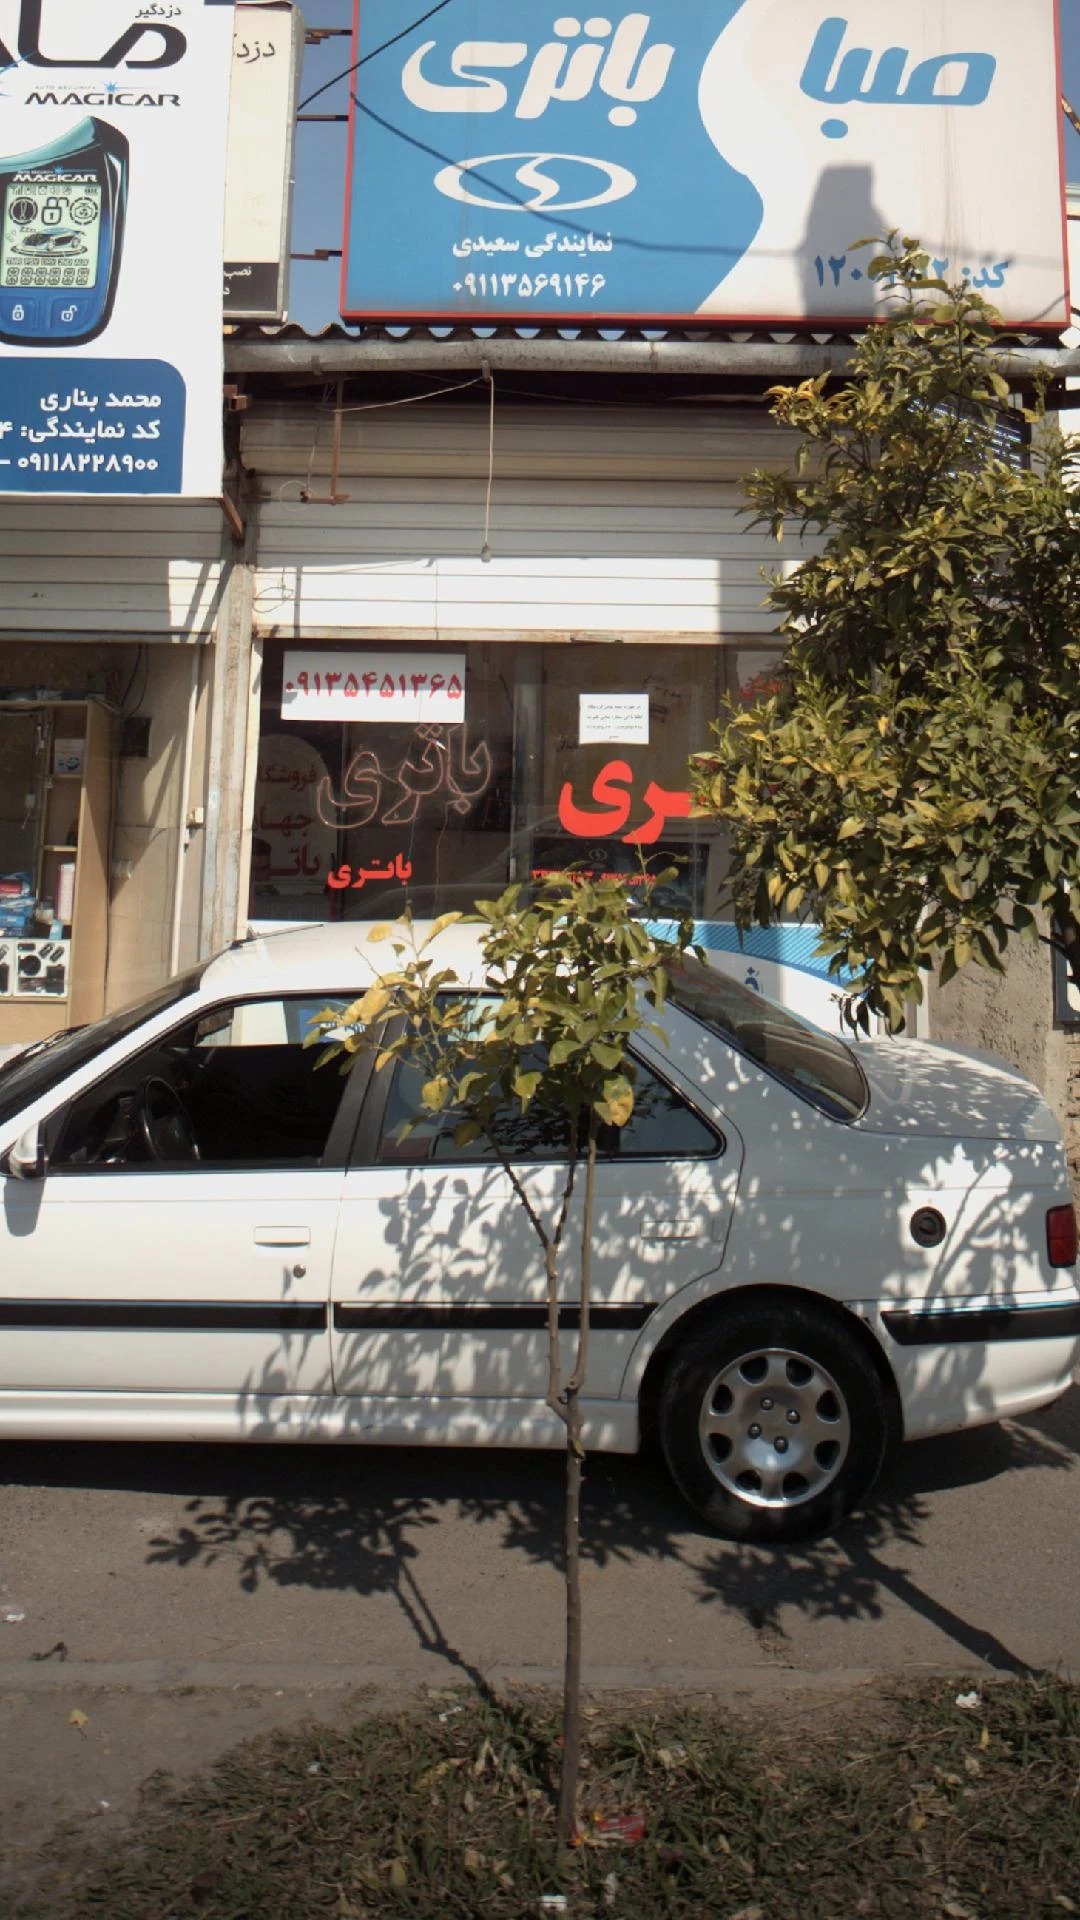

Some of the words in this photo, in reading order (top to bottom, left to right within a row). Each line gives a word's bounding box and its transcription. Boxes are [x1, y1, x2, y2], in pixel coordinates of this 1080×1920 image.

[135, 4, 181, 18] دزدگیر
[234, 33, 275, 64] دزد
[402, 13, 676, 127] باتری
[800, 17, 997, 139] صبا
[24, 92, 182, 107] MAGICAR
[13, 174, 97, 182] MAGICAR
[452, 236, 520, 258] سعیدی
[524, 232, 613, 258] نمایندگی
[452, 273, 606, 297] ۰۹۱۱۳۵۶۹۱۴۶
[40, 388, 98, 412] بناری
[105, 392, 161, 407] محمد
[132, 420, 160, 439] کد
[285, 671, 463, 700] ۰۹۱۳۵۴۵۱۳۶۵
[317, 723, 492, 836] باتری
[327, 852, 412, 889] باتری
